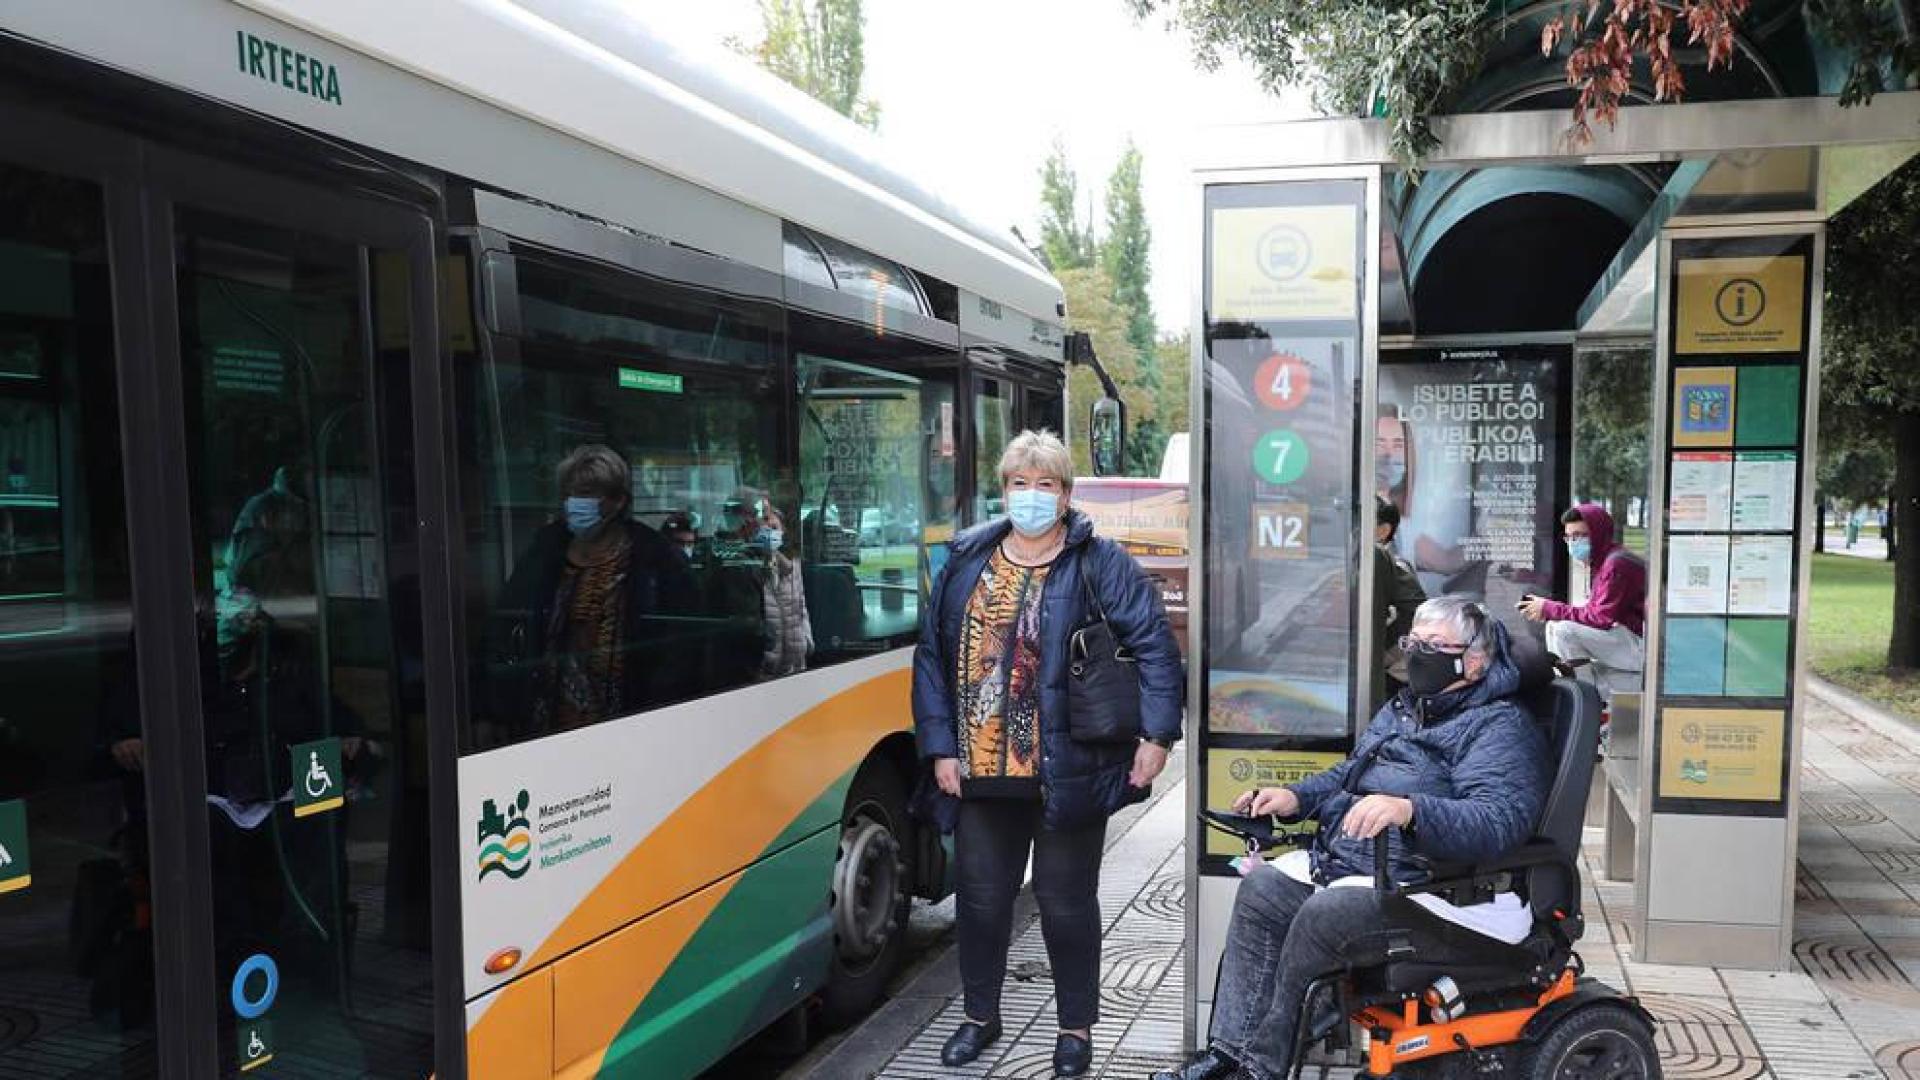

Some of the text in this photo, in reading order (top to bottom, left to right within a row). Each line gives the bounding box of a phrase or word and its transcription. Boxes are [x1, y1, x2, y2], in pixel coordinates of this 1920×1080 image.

[236, 30, 342, 105] IRTEERA
[1271, 364, 1292, 400] 4
[1519, 382, 1537, 401] A
[1397, 404, 1429, 422] LO
[1420, 425, 1537, 443] PUBLIKOA
[1270, 441, 1292, 475] 7
[1258, 514, 1304, 549] N2
[539, 782, 612, 819] Mancomunidad
[539, 802, 612, 834] Comarca de Pamplona
